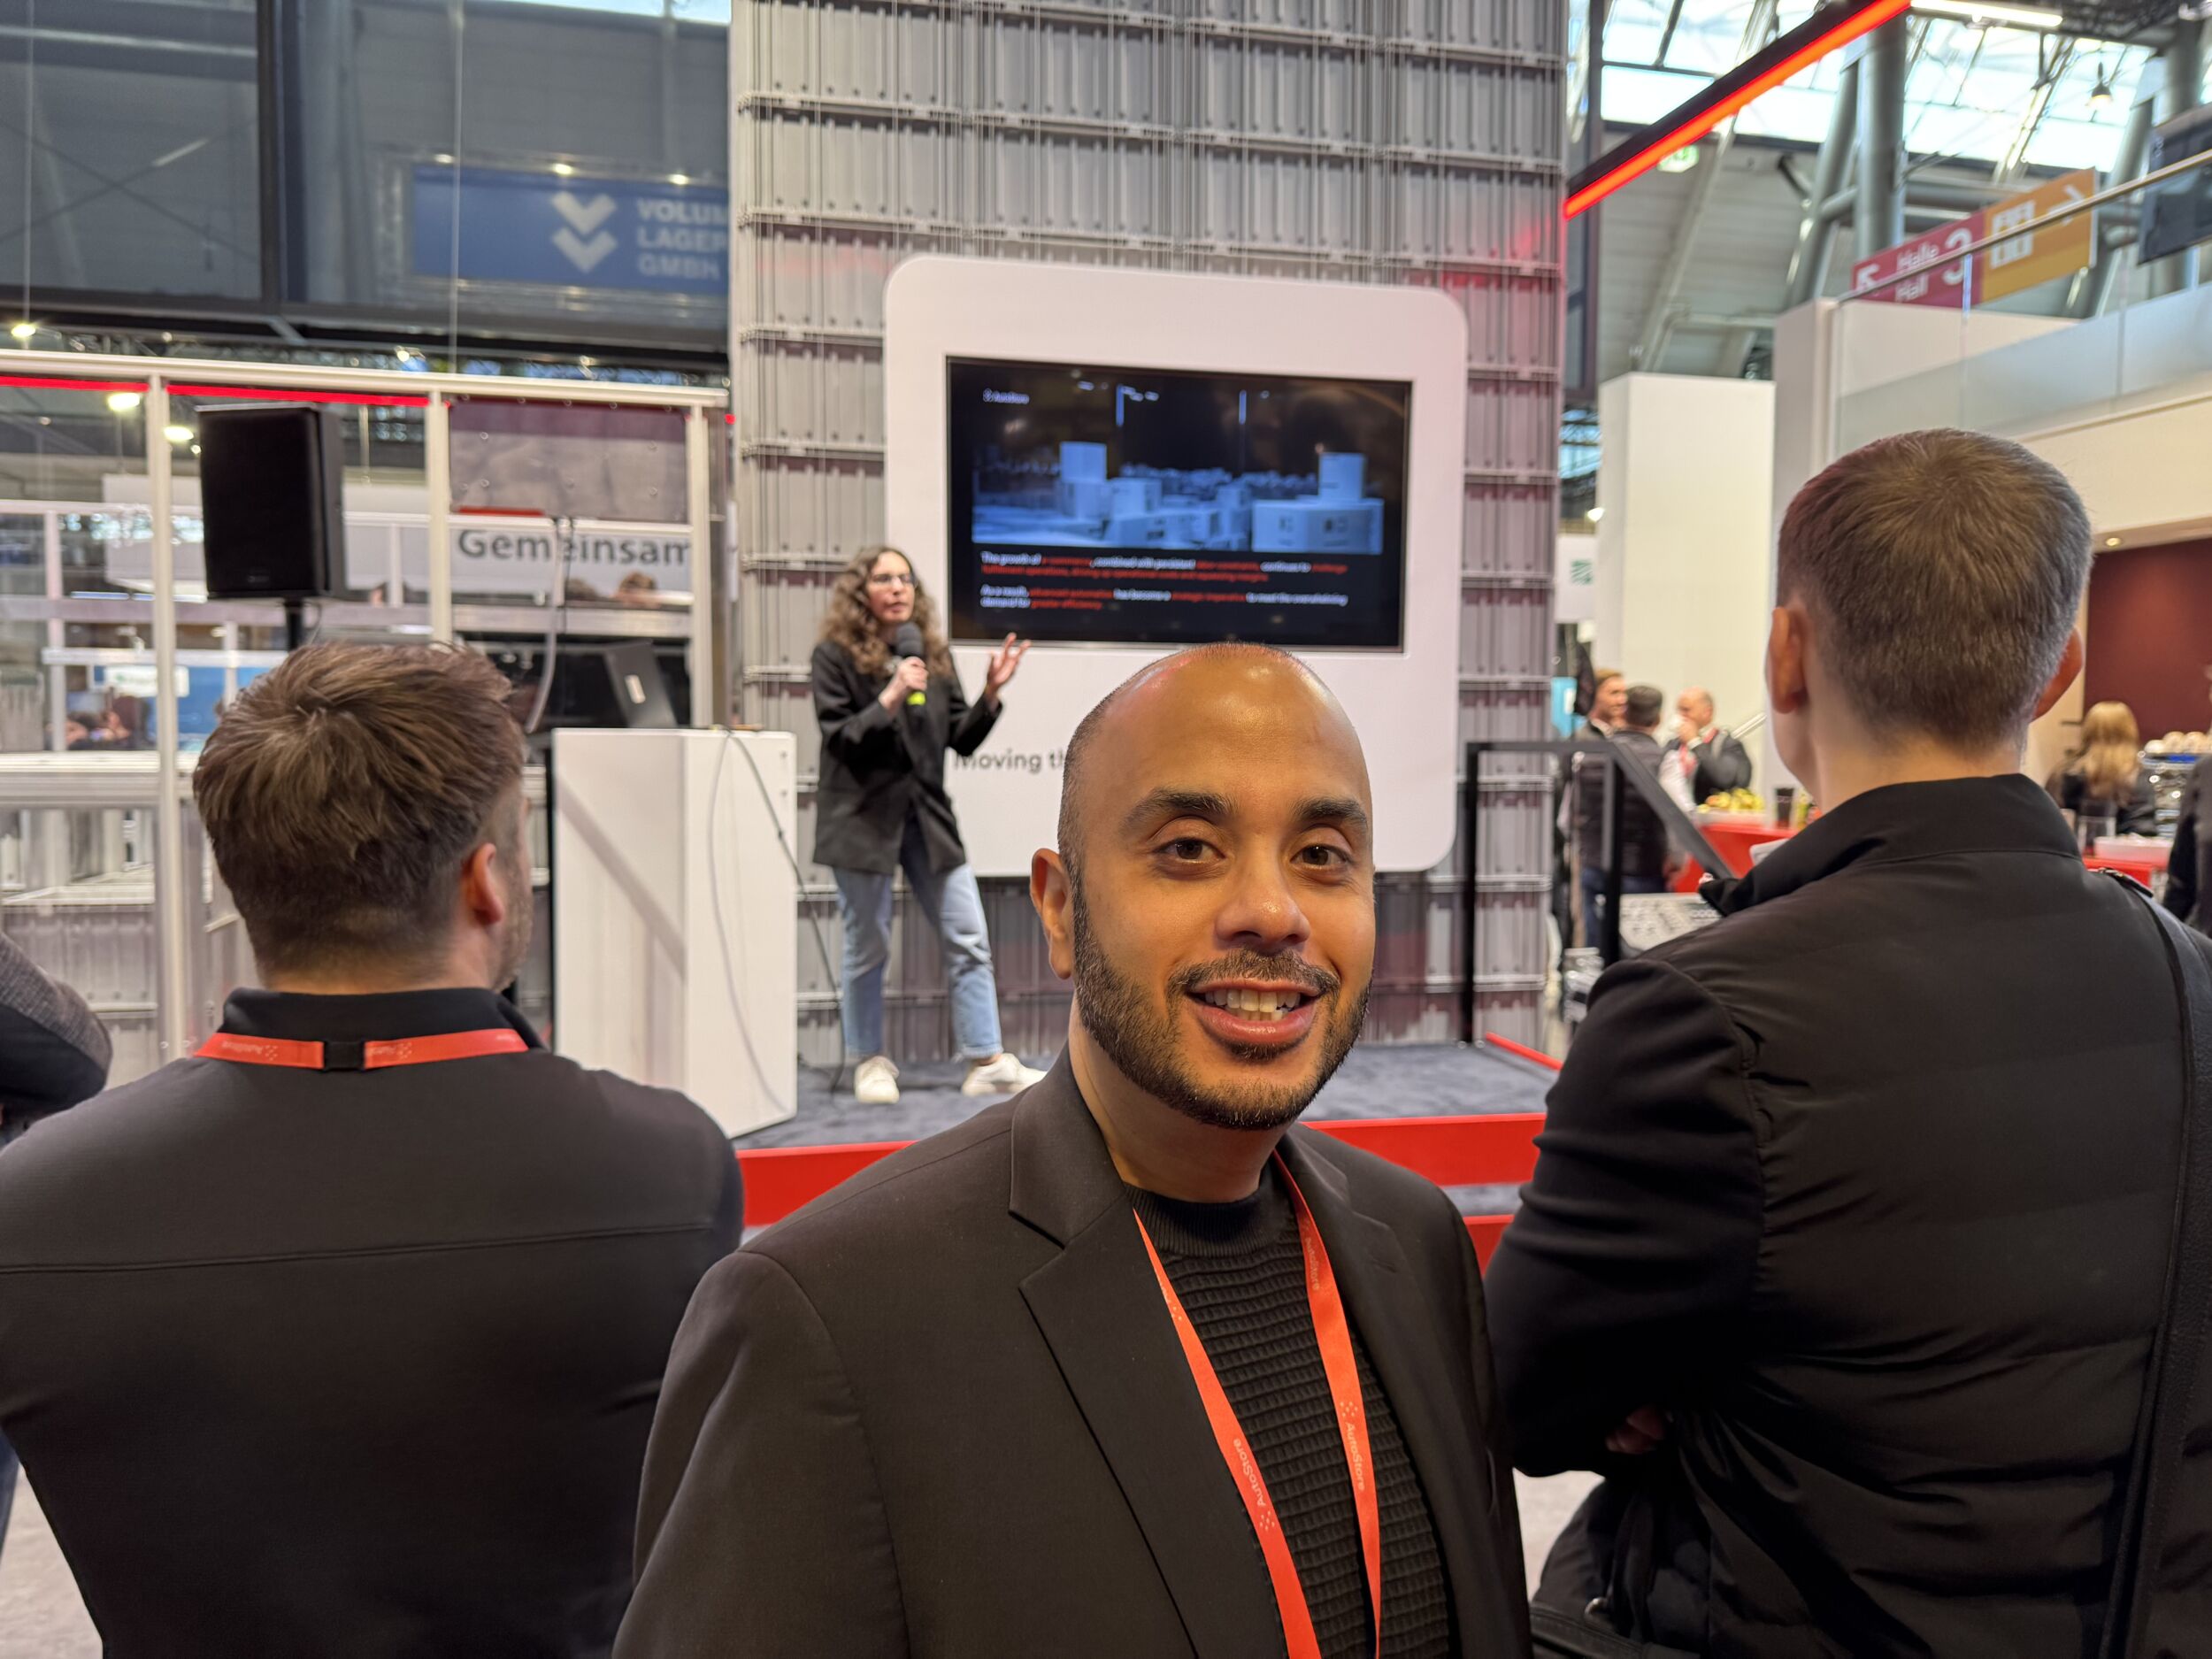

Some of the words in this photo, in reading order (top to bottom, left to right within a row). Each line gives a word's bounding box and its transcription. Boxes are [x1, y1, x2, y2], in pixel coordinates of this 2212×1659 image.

[1943, 227, 1972, 286] 3
[1233, 1438, 1266, 1507] AutoStore
[1345, 1422, 1365, 1492] AutoStore
